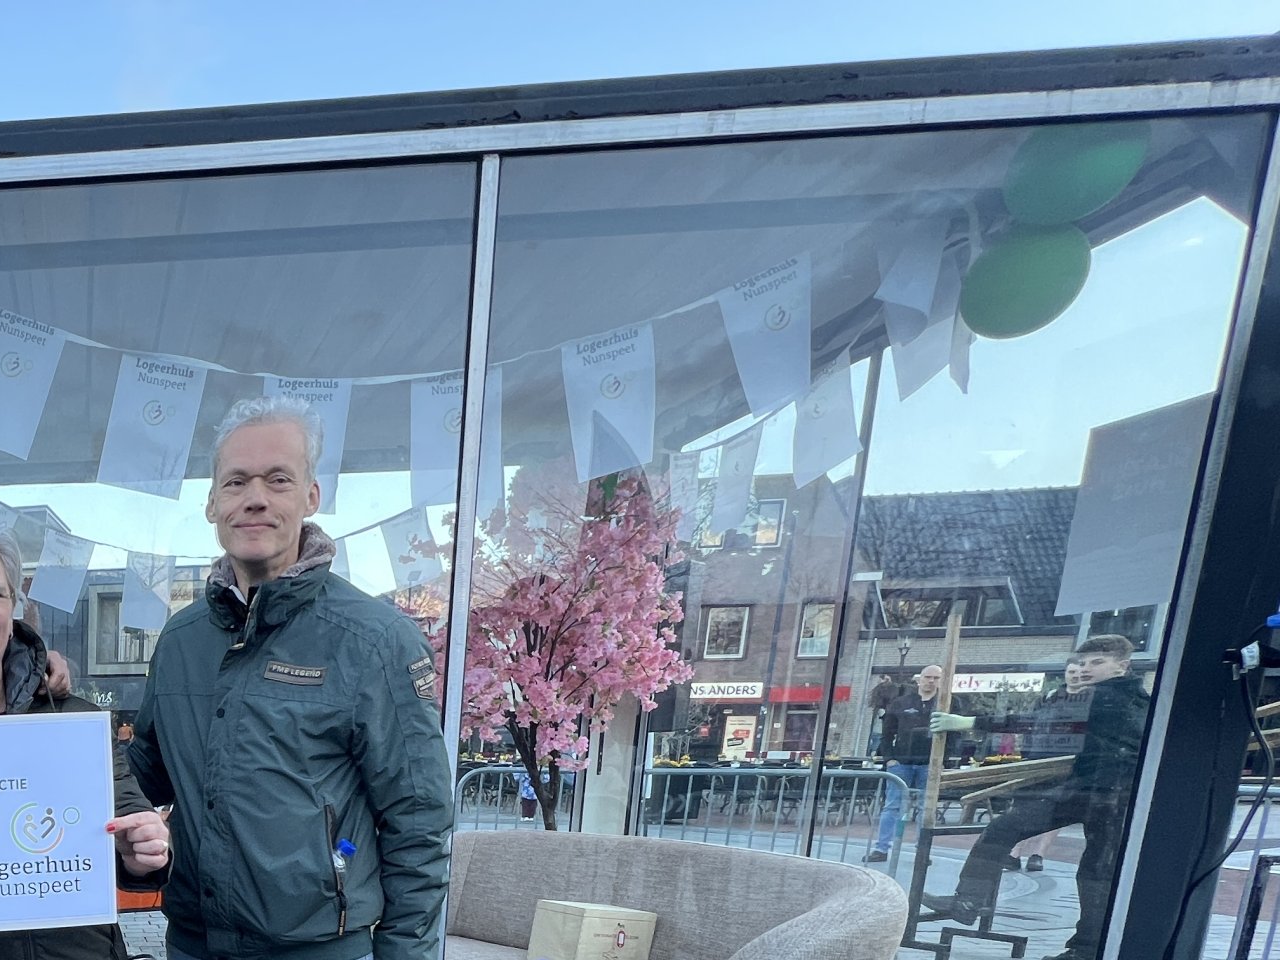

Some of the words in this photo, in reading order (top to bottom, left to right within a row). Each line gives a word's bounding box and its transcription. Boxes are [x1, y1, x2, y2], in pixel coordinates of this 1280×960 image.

[743, 271, 798, 302] Nunspeet
[0, 321, 47, 346] Nunspeet
[576, 327, 639, 355] Logeerhuis
[582, 343, 636, 367] Nunspeet
[136, 357, 194, 379] Logeerhuis
[137, 372, 186, 391] Nunspeet
[278, 378, 339, 391] Logeerhuis
[431, 385, 463, 396] Nuns
[691, 686, 705, 695] NS
[708, 685, 757, 695] ANDERS
[958, 675, 981, 691] ely
